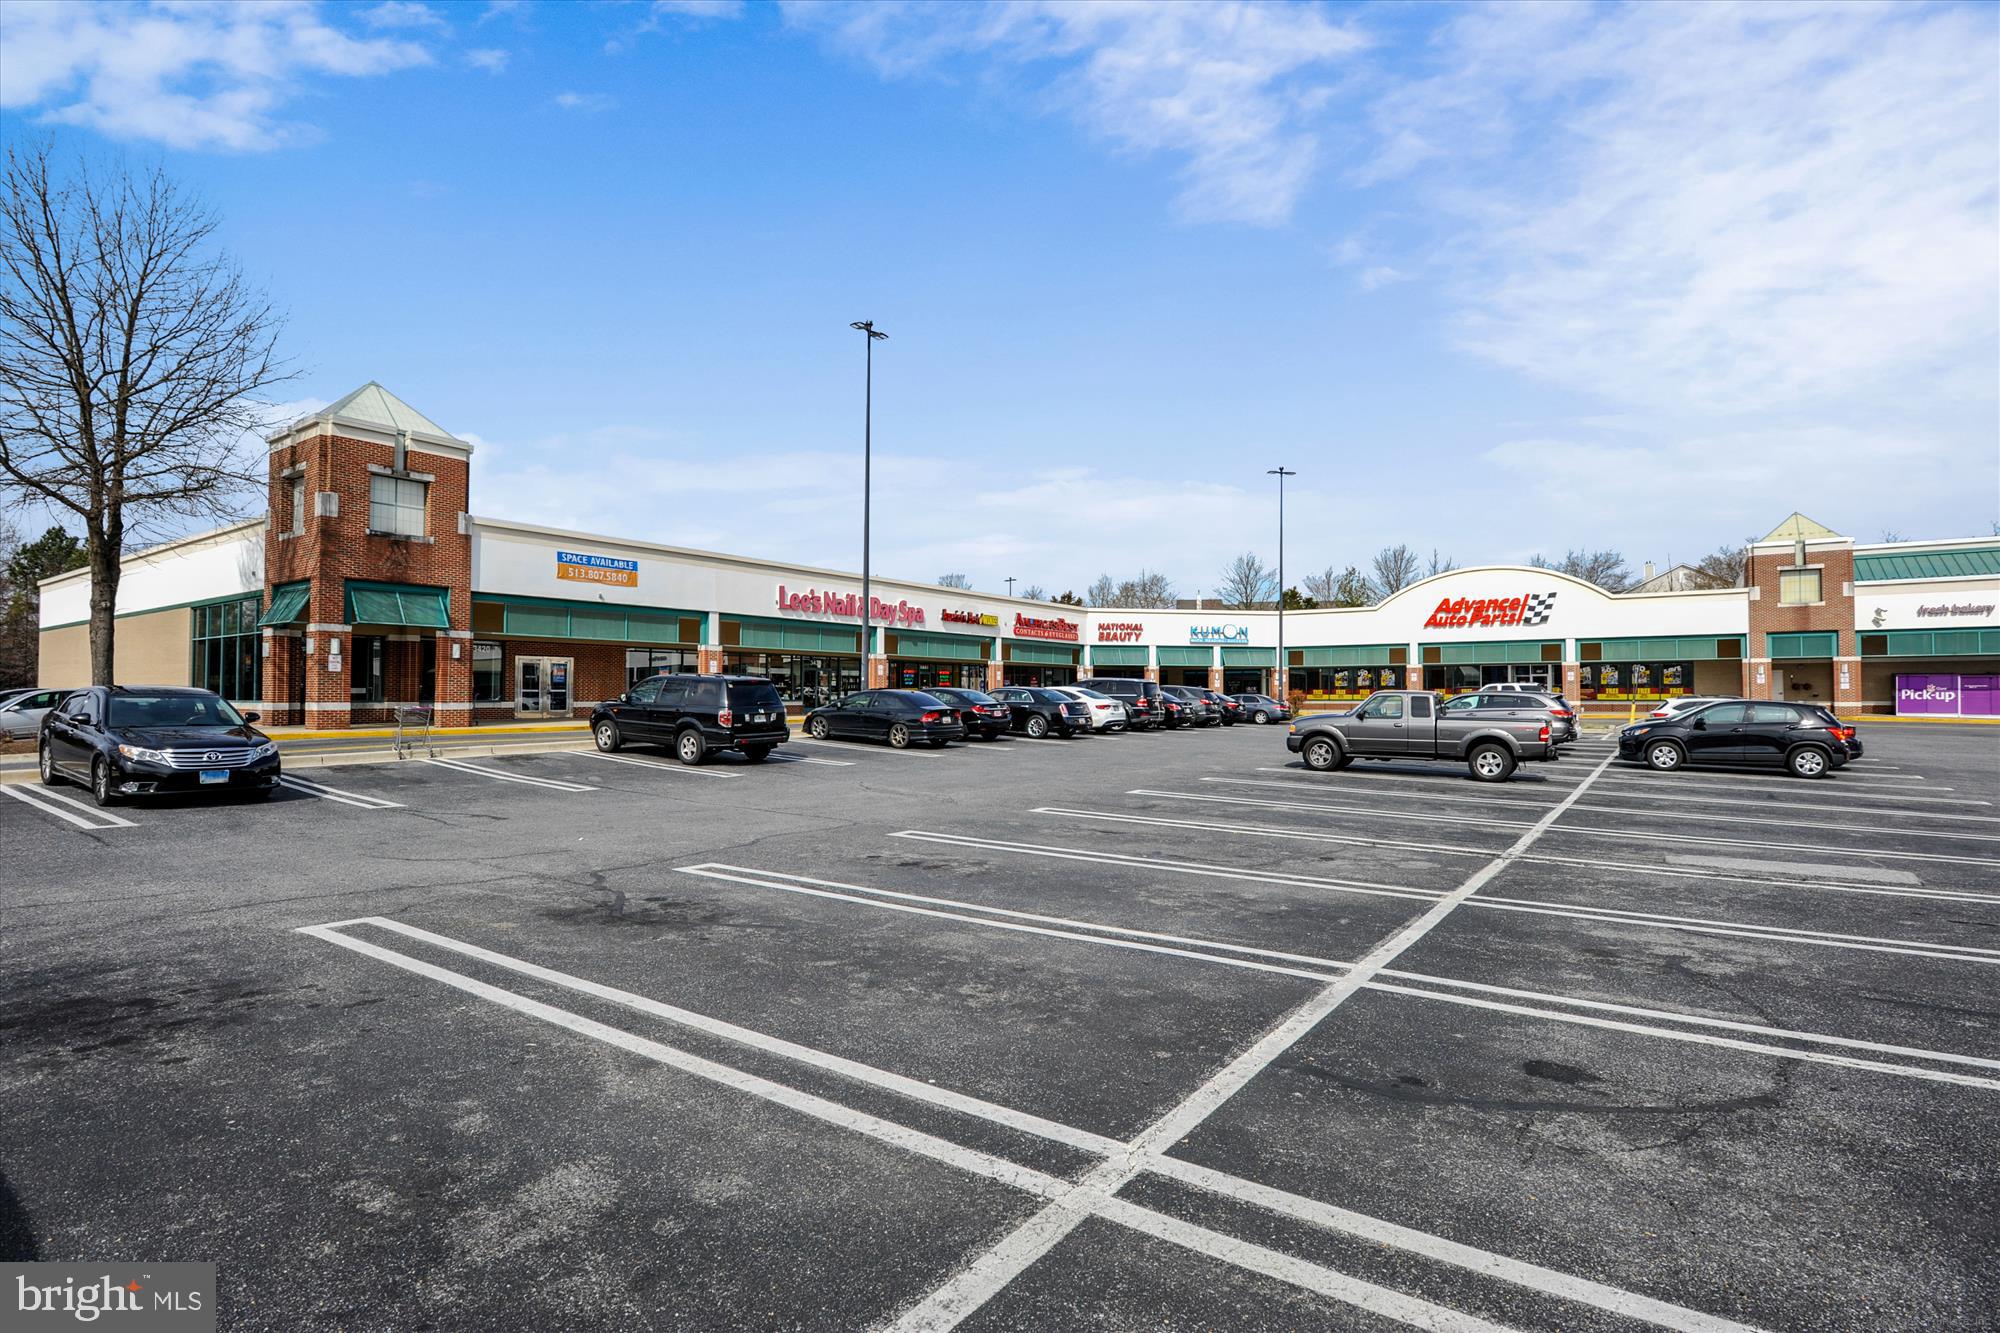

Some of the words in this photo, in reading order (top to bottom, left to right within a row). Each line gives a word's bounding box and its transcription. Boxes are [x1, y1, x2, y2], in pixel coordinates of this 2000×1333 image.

[561, 553, 588, 565] SPACE
[590, 556, 634, 570] AVAILABLE
[568, 567, 628, 583] 513.807.5840
[778, 585, 822, 613] Lee's
[823, 591, 857, 617] Nail
[870, 597, 898, 625] Day
[899, 600, 925, 626] Spa
[1433, 596, 1521, 615] Advance
[1917, 604, 1949, 617] fresh
[1950, 603, 1995, 617] bakery
[1097, 622, 1144, 632] NATIONAL
[1424, 613, 1467, 628] Auto
[1469, 611, 1518, 628] Parts
[1097, 631, 1142, 643] BEAUTY
[1190, 624, 1249, 639] KUMON
[1901, 689, 1956, 702] Pick-up
